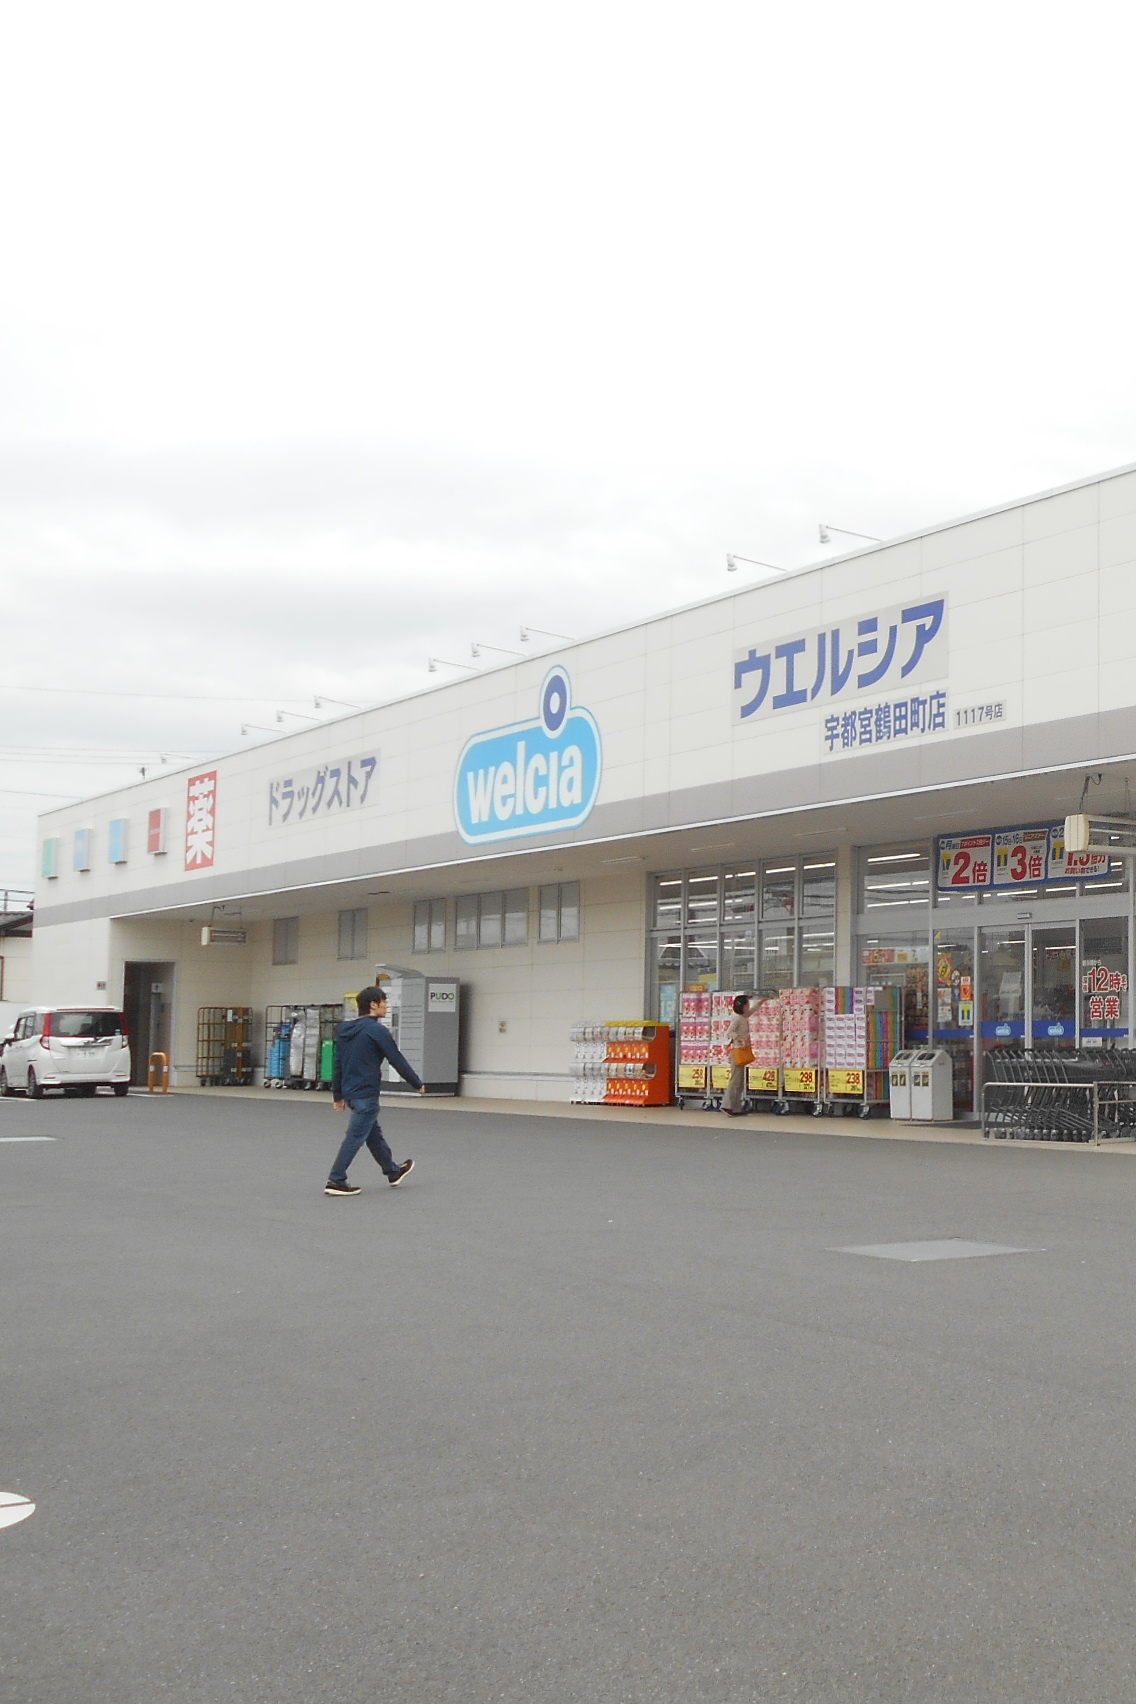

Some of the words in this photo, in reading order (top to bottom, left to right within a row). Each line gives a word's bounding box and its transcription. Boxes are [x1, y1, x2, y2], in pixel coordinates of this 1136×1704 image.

[734, 598, 945, 719] ウエルシア
[824, 690, 947, 752] 宇都宮鶴田町店
[956, 702, 1003, 727] 1117号店
[268, 755, 377, 827] ドラッグストア
[466, 739, 583, 824] welcia
[185, 777, 215, 866] 薬
[951, 851, 988, 885] 2倍
[1010, 845, 1043, 881] 3倍
[430, 992, 454, 1000] PUDO
[1090, 996, 1119, 1019] 営業
[800, 1071, 813, 1083] 298
[846, 1072, 860, 1084] 238
